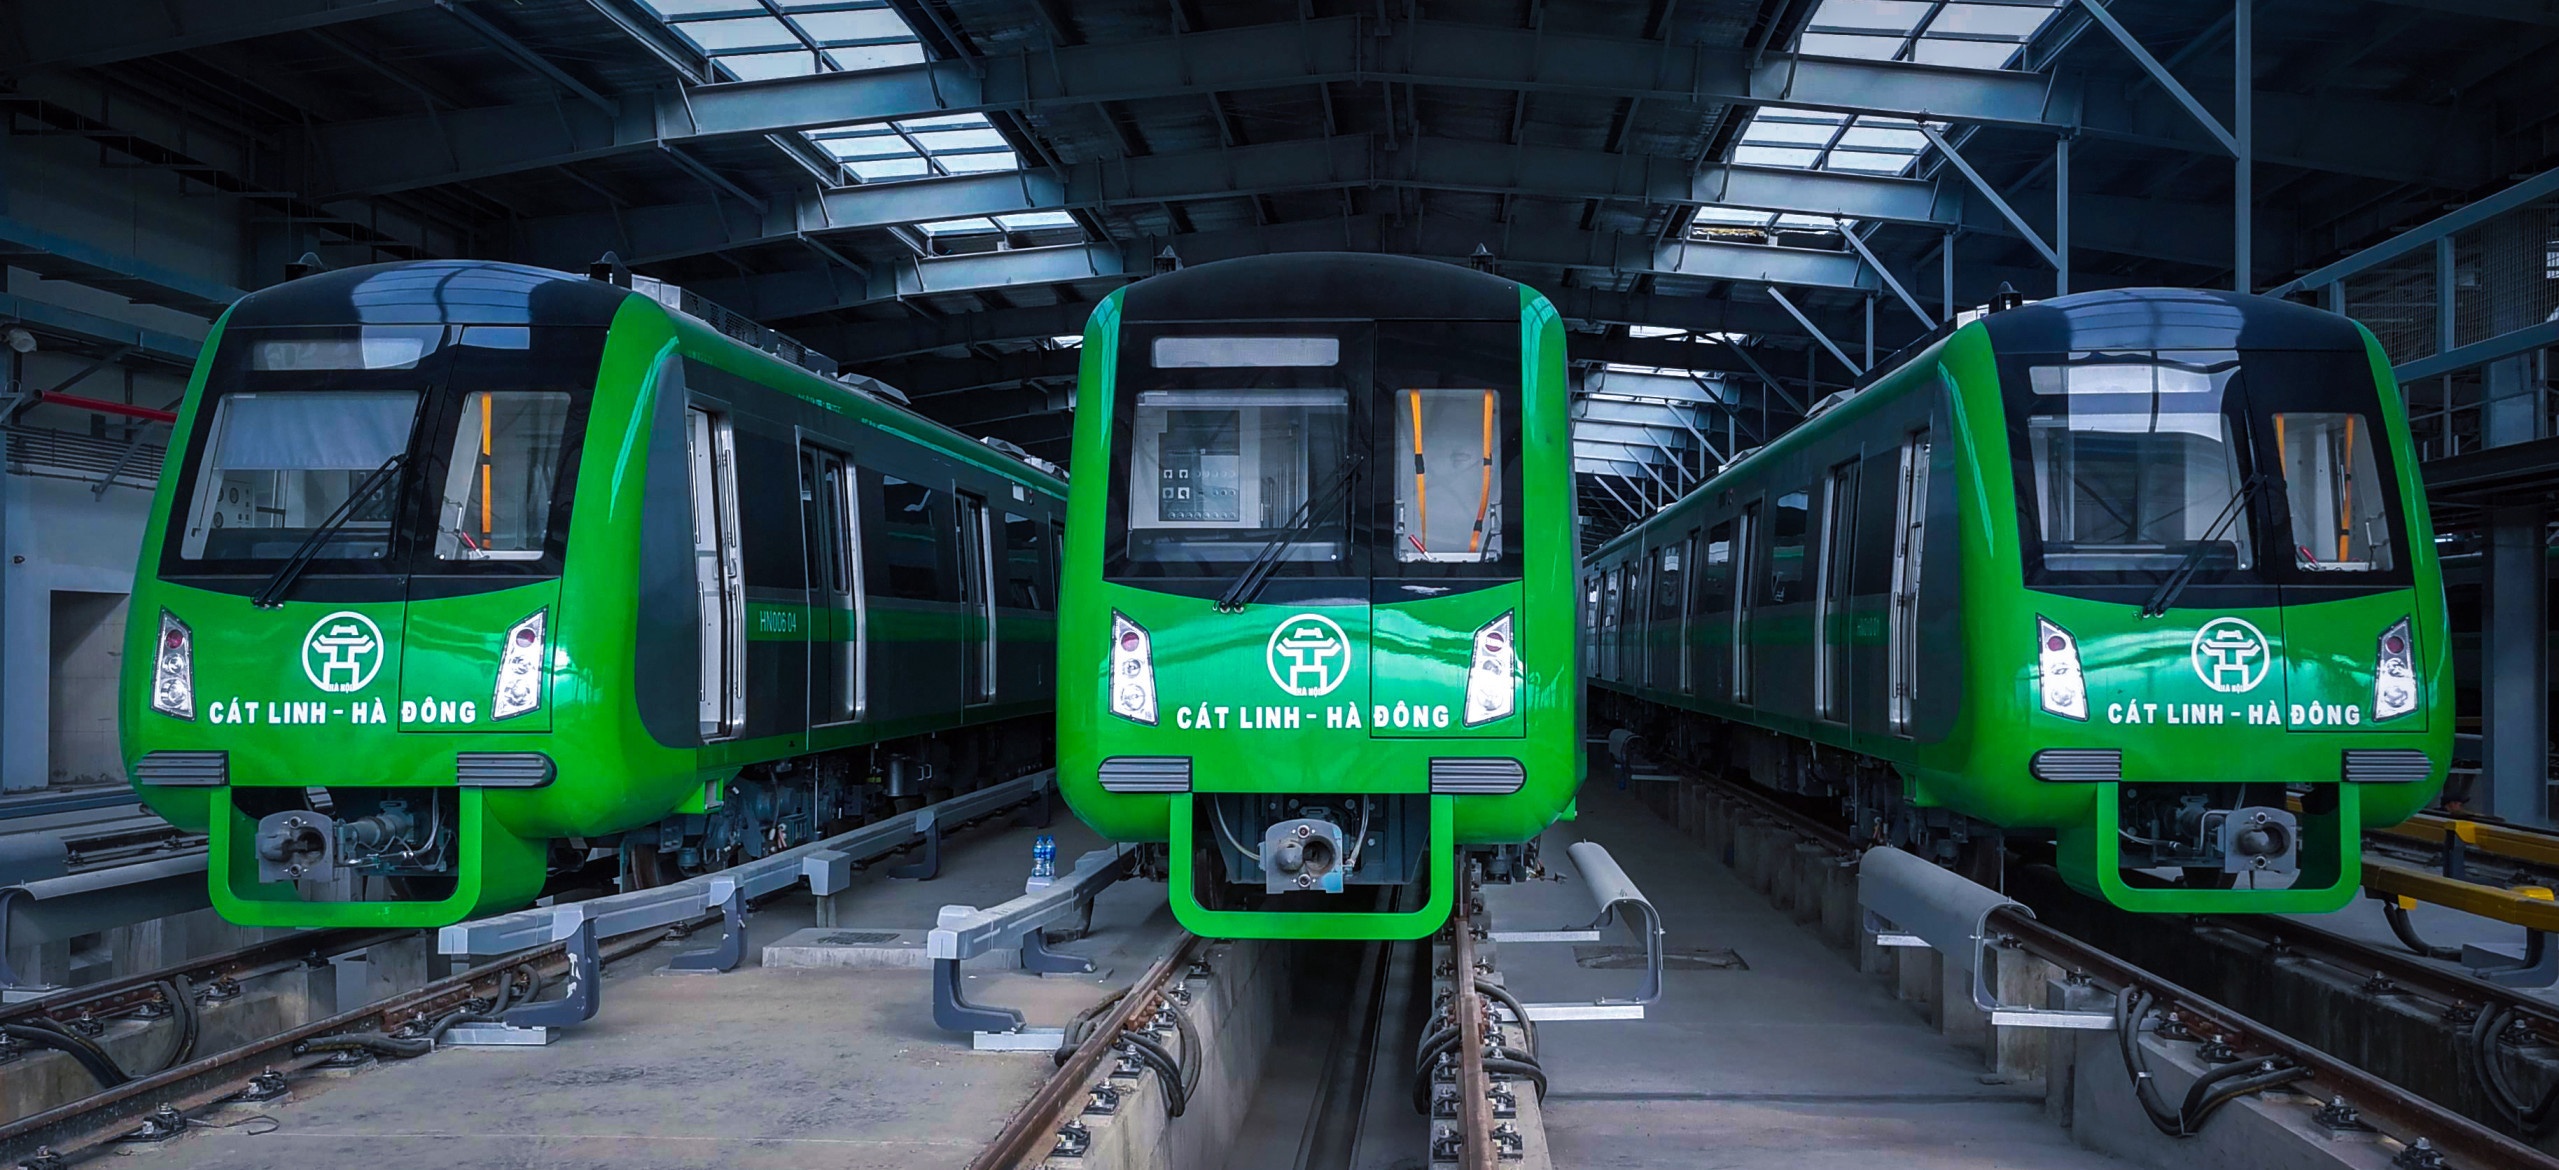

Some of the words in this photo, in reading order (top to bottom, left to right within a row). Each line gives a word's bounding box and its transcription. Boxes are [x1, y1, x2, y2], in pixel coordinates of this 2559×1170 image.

[759, 610, 786, 632] HN006
[787, 612, 797, 633] 04
[209, 697, 260, 724] CÁT
[268, 702, 326, 724] LINH
[351, 697, 387, 724] HÀ
[401, 696, 476, 723] ĐÔNG
[1176, 702, 1230, 729] CÁT
[1239, 706, 1300, 729] LINH
[1326, 701, 1362, 729] HÀ
[1373, 700, 1449, 728] ĐÔNG
[2107, 698, 2157, 724] CÁT
[2167, 703, 2224, 724] LINH
[2248, 701, 2281, 725] HÀ
[2290, 700, 2360, 725] ĐÔNG
